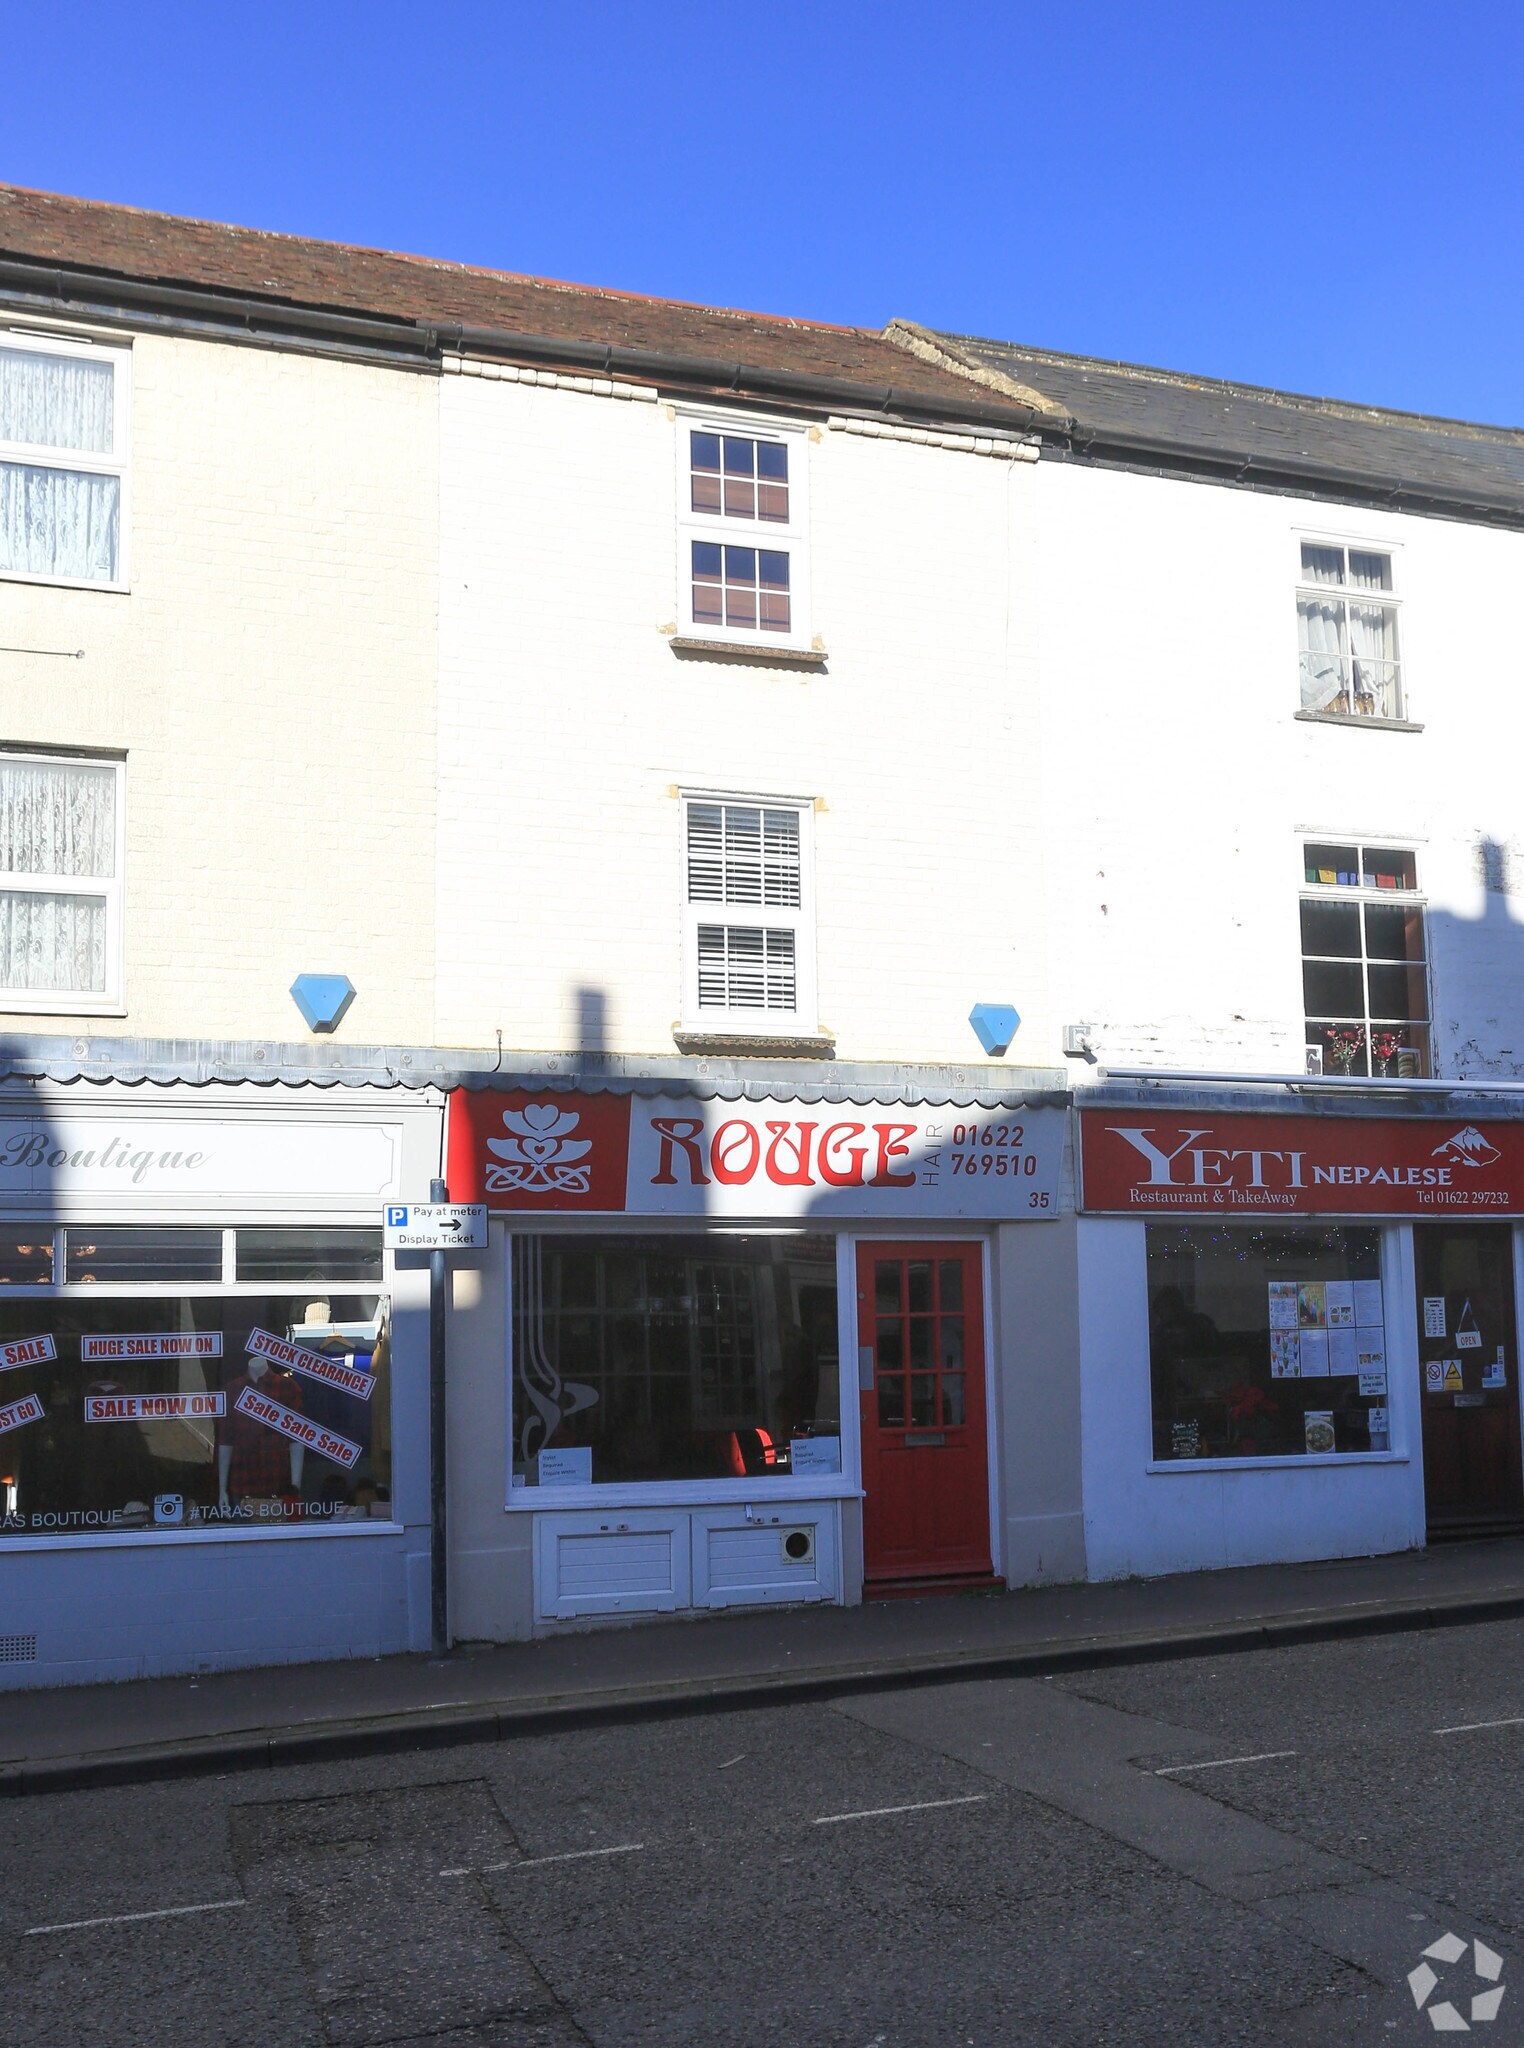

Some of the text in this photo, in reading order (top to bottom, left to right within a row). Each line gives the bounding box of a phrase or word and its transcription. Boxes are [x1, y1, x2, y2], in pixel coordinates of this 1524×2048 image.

[953, 1124, 1024, 1147] 01622
[0, 1132, 215, 1184] Boutique
[650, 1117, 918, 1188] ROUGE
[921, 1125, 943, 1186] HAIR
[1104, 1127, 1309, 1188] YETI
[951, 1153, 1037, 1176] 769510
[1312, 1166, 1454, 1186] NEPALESE
[1028, 1192, 1050, 1208] 35
[1130, 1188, 1297, 1207] Restaurant & TakeAway
[1416, 1190, 1509, 1204] Tel 01622 297232
[391, 1209, 404, 1225] P
[413, 1206, 482, 1217] Pay at meter
[399, 1234, 475, 1245] Display Ticket
[89, 1338, 213, 1355] HUGE SALE NOW ON
[1461, 1336, 1477, 1346] OPEN
[4, 1340, 47, 1364] SALE
[254, 1335, 368, 1392] STOCK CLEARANCE
[17, 1402, 36, 1420] GO
[92, 1397, 216, 1417] SALE NOW ON
[243, 1394, 353, 1461] Sale Sale Sale
[32, 1510, 122, 1527] BOUTIQUE
[189, 1501, 344, 1520] #TARAS BOUTIQUE
